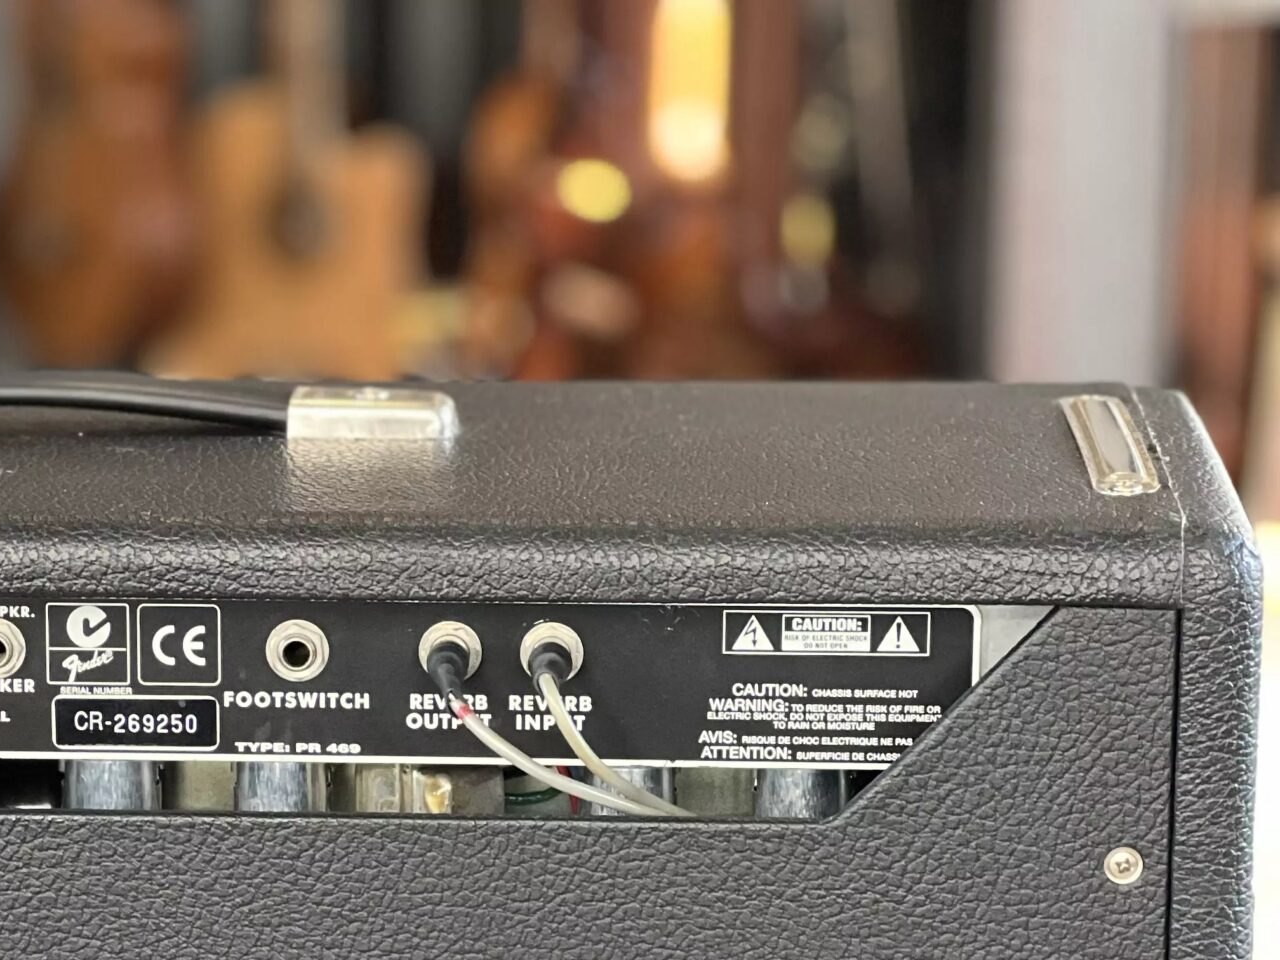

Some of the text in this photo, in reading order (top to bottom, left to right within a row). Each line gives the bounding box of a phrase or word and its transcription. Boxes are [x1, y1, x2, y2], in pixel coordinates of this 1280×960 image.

[792, 617, 863, 632] CAUTION:
[151, 624, 207, 666] CE
[60, 686, 133, 695] SERIAL NUMBER
[732, 683, 918, 698] CAUTION: CHASSIS SURFACE HOT
[223, 691, 370, 709] FOOTSWITCH
[409, 693, 488, 711] REVRB
[508, 695, 593, 712] REVRB
[709, 698, 941, 714] WARNING: TO REDUCE THE RISK OF FIRE OR
[74, 710, 198, 733] CR-269250
[405, 712, 492, 730] OUTPT
[516, 714, 586, 731] INPT
[707, 711, 751, 720] ELECTRIC
[753, 712, 787, 721] SHOCK,
[805, 713, 825, 721] NOT
[827, 713, 864, 721] EXPOSE
[865, 714, 886, 722] THIS
[773, 721, 875, 731] TO RAIN OR MOISTURE
[698, 730, 913, 746] AVIS: RISQUE DE CHOC ELECTRIQUE NE PAS
[234, 741, 361, 754] TYPE: PR 469
[700, 745, 792, 760] ATTENTION:
[796, 751, 850, 760] SUPERFICIE
